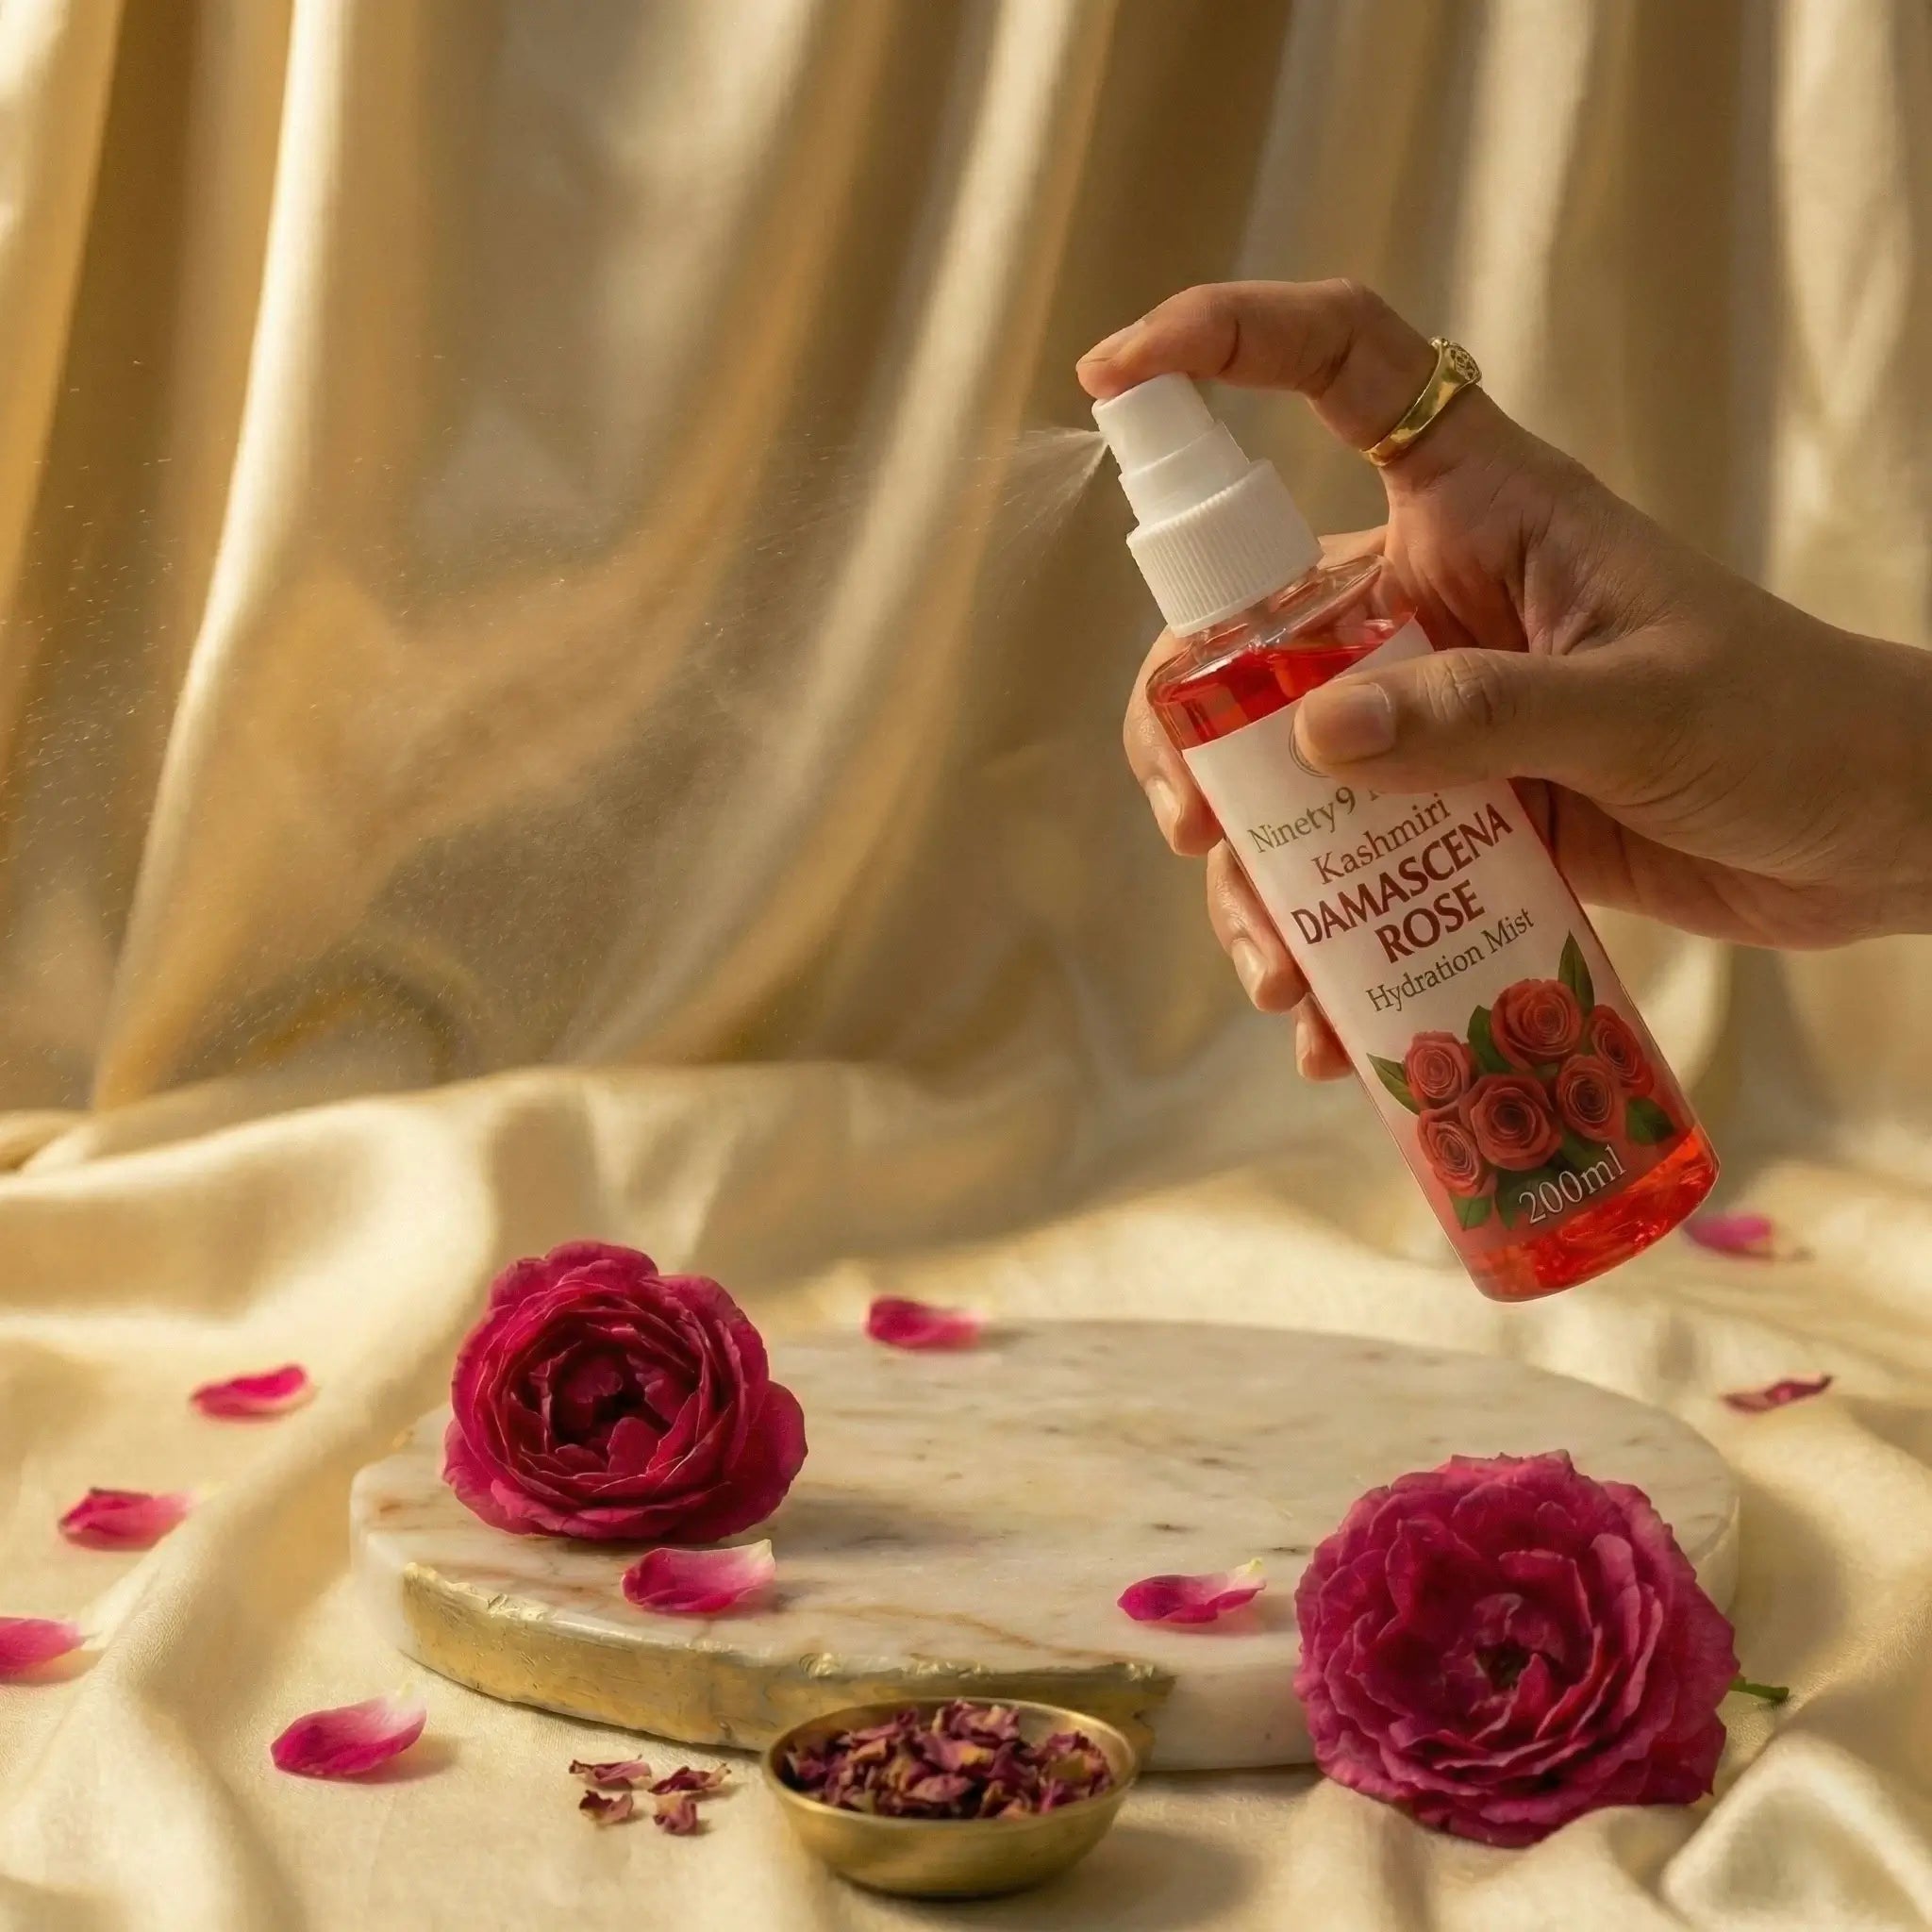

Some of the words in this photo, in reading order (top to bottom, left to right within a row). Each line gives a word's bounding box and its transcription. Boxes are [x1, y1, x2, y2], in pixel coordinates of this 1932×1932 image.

[1247, 786, 1356, 853] Ninety9
[1311, 792, 1451, 884] Kashmiri
[1291, 803, 1513, 944] DAMASCENA
[1365, 944, 1485, 1012] Hydration
[1481, 908, 1535, 955] Mist
[1374, 879, 1486, 964] ROSE
[1519, 1143, 1627, 1224] 200ml
